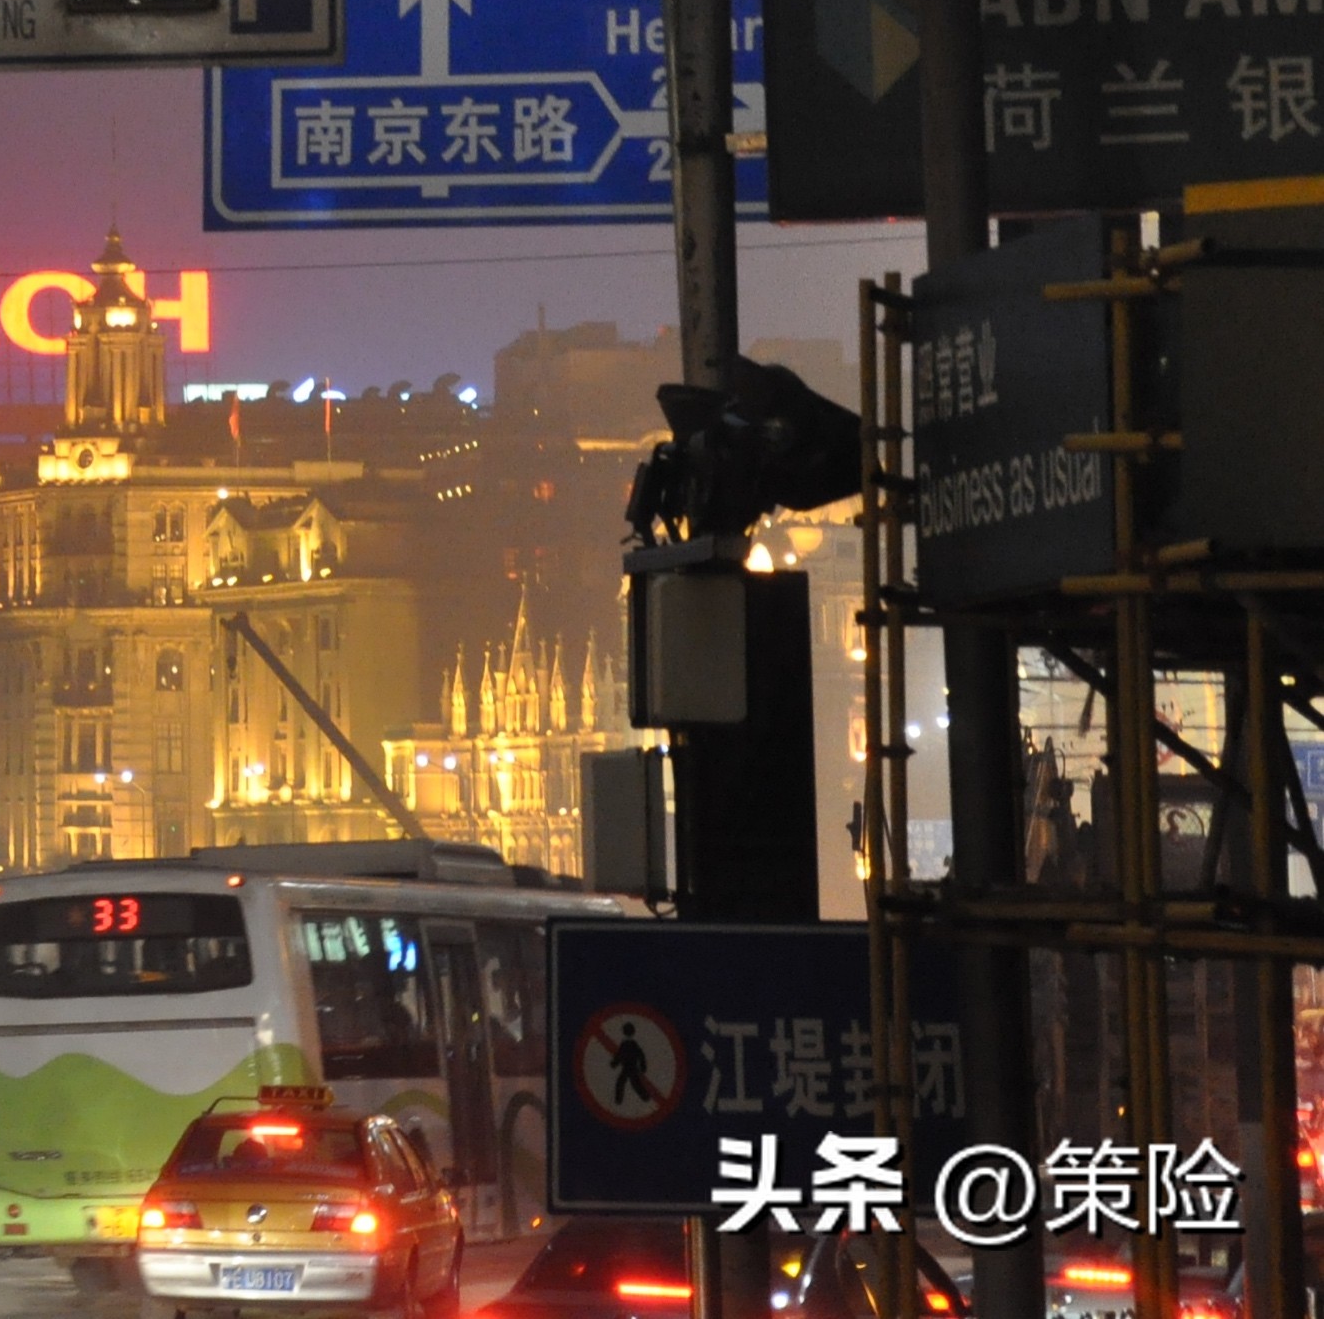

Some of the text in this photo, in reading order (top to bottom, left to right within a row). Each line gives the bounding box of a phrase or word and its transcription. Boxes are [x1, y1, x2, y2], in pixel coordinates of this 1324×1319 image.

[295, 96, 578, 167] 南京东路
[982, 54, 1323, 153] 荷兰银
[919, 416, 1102, 538] Business as usual
[92, 897, 138, 932] 33
[270, 1087, 320, 1099] TAXI
